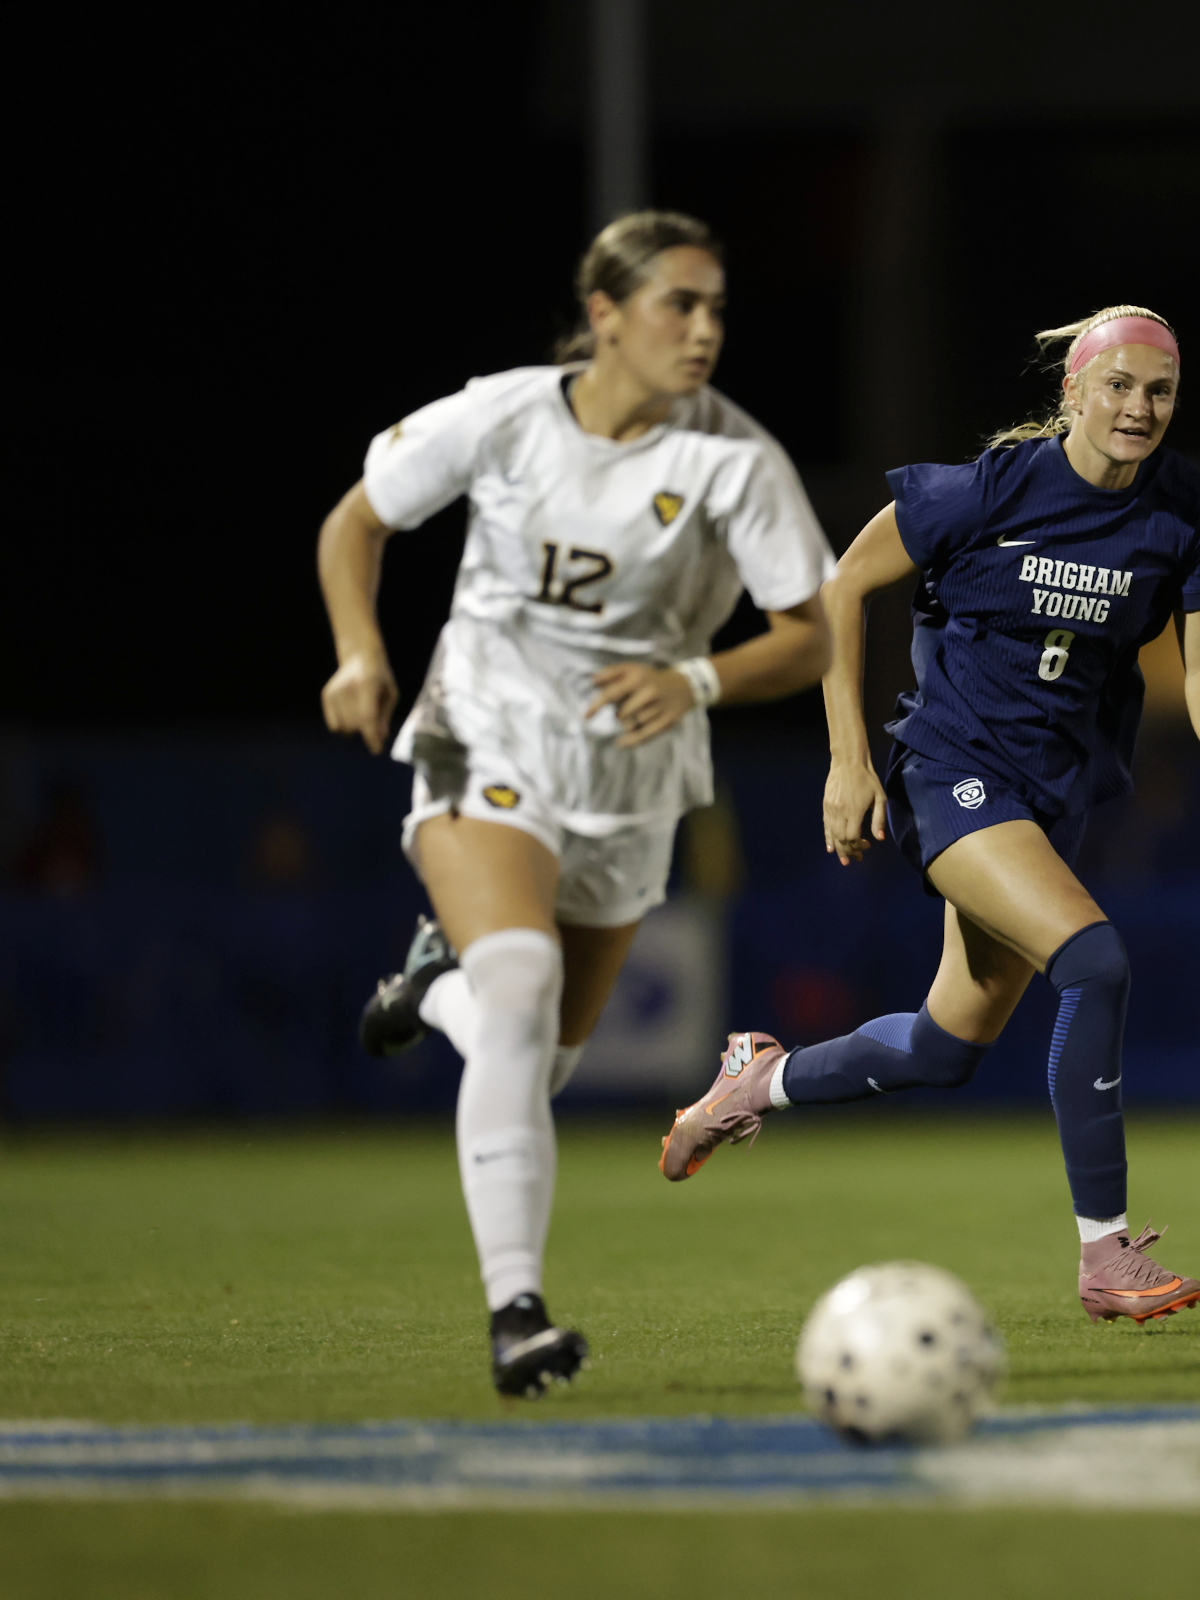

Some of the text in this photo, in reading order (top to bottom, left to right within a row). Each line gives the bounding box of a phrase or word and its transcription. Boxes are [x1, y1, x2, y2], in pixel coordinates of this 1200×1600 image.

[541, 541, 613, 615] 12
[1018, 554, 1133, 597] BRIGHAM
[1030, 587, 1111, 624] YOUNG
[1037, 628, 1076, 682] 8
